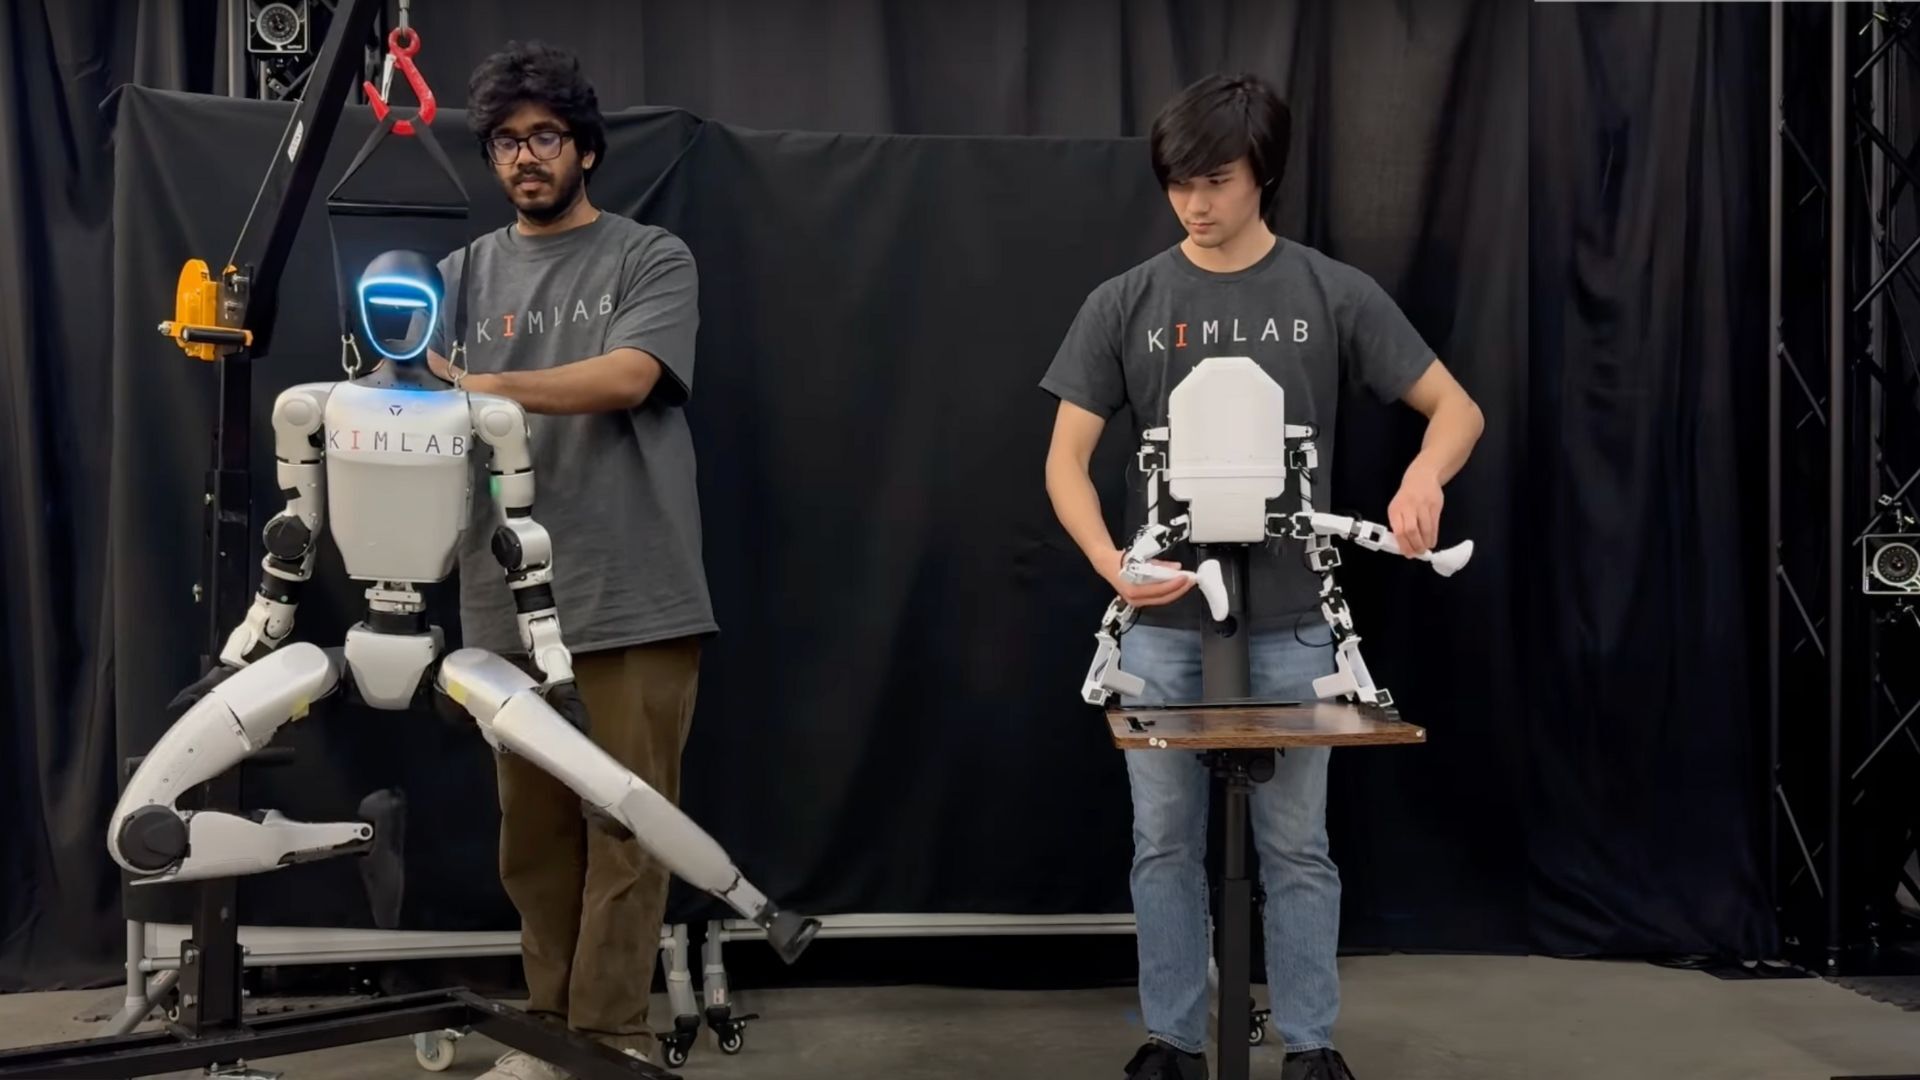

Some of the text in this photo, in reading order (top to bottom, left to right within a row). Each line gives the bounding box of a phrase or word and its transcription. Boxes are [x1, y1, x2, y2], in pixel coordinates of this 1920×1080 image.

[476, 293, 612, 343] KIMLAB
[1147, 318, 1309, 353] KIMLAB
[329, 430, 464, 456] KIMLAB
